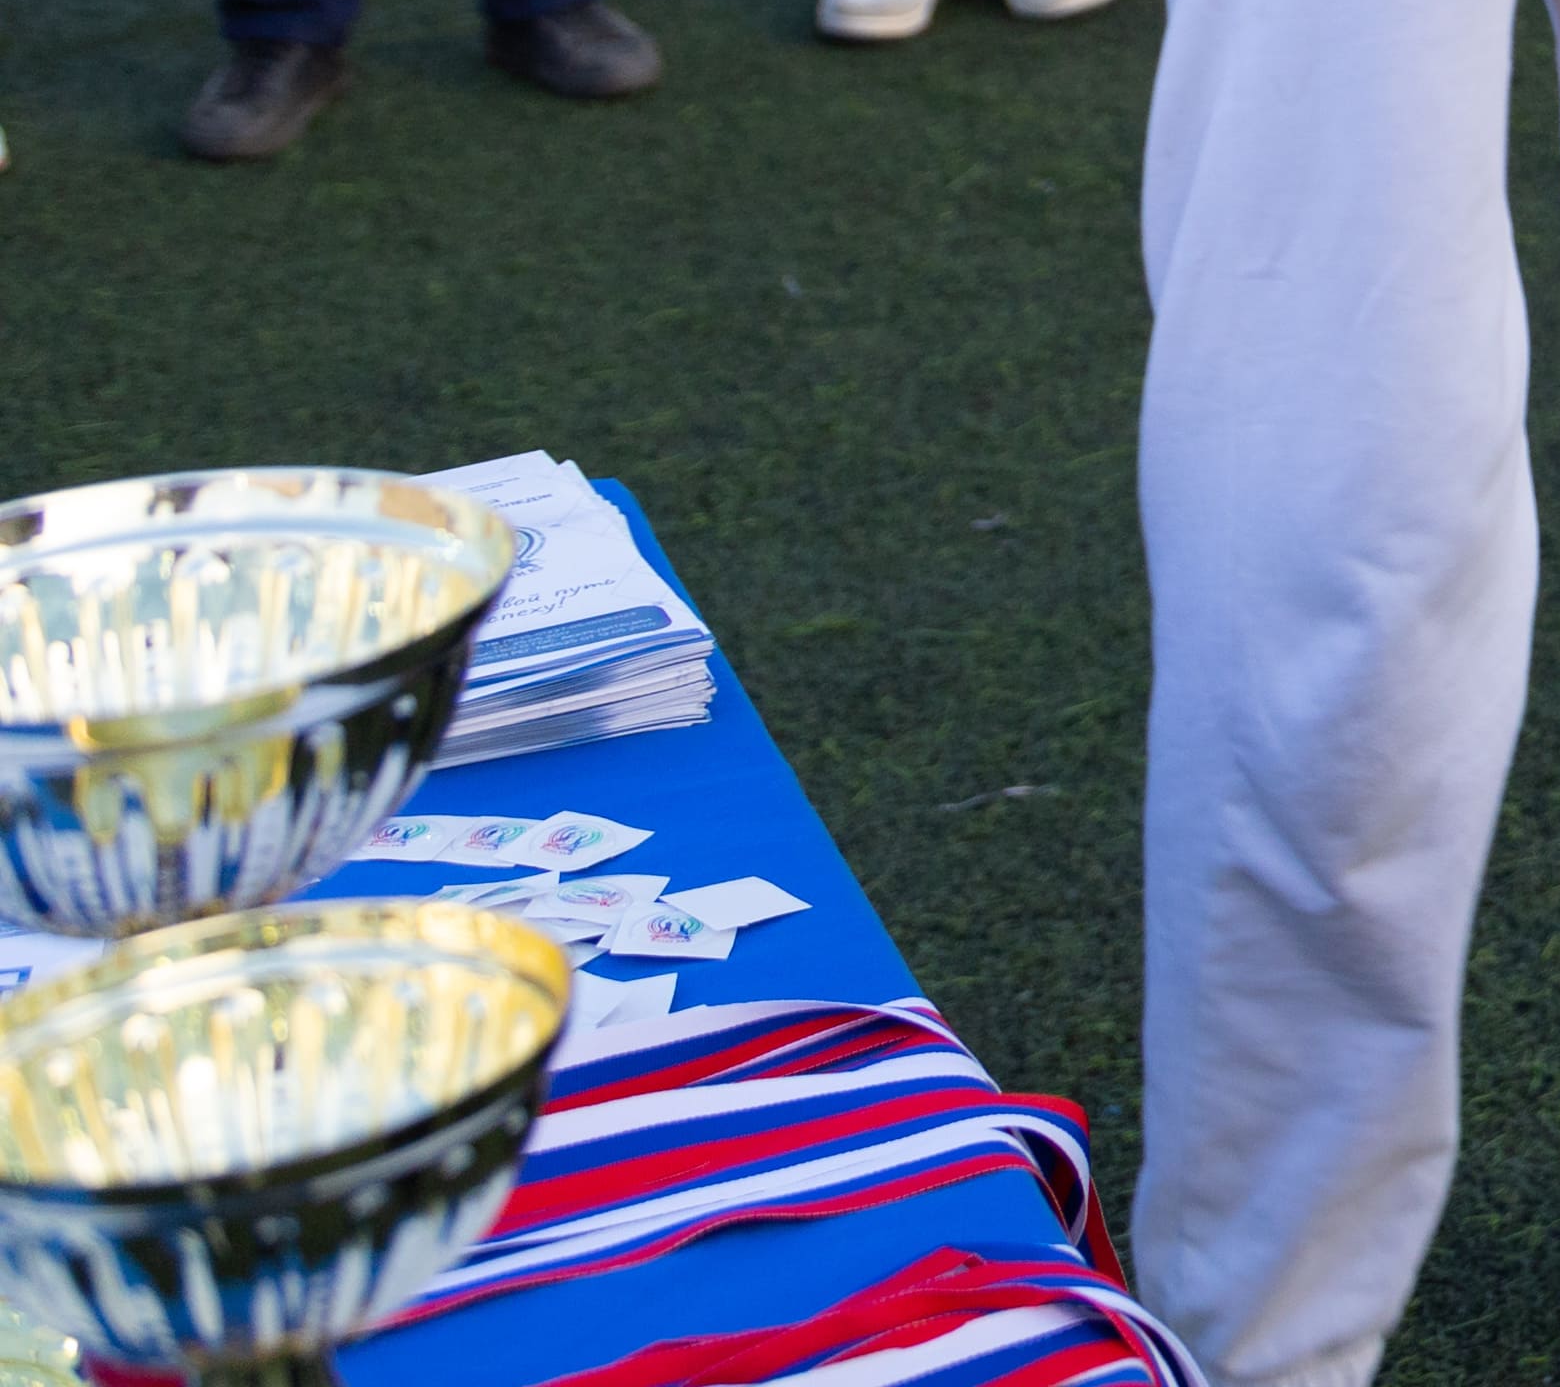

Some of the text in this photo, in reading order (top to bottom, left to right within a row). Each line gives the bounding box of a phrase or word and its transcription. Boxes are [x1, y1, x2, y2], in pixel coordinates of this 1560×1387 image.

[486, 597, 567, 624] спеху!
[492, 578, 617, 613] вой путь
